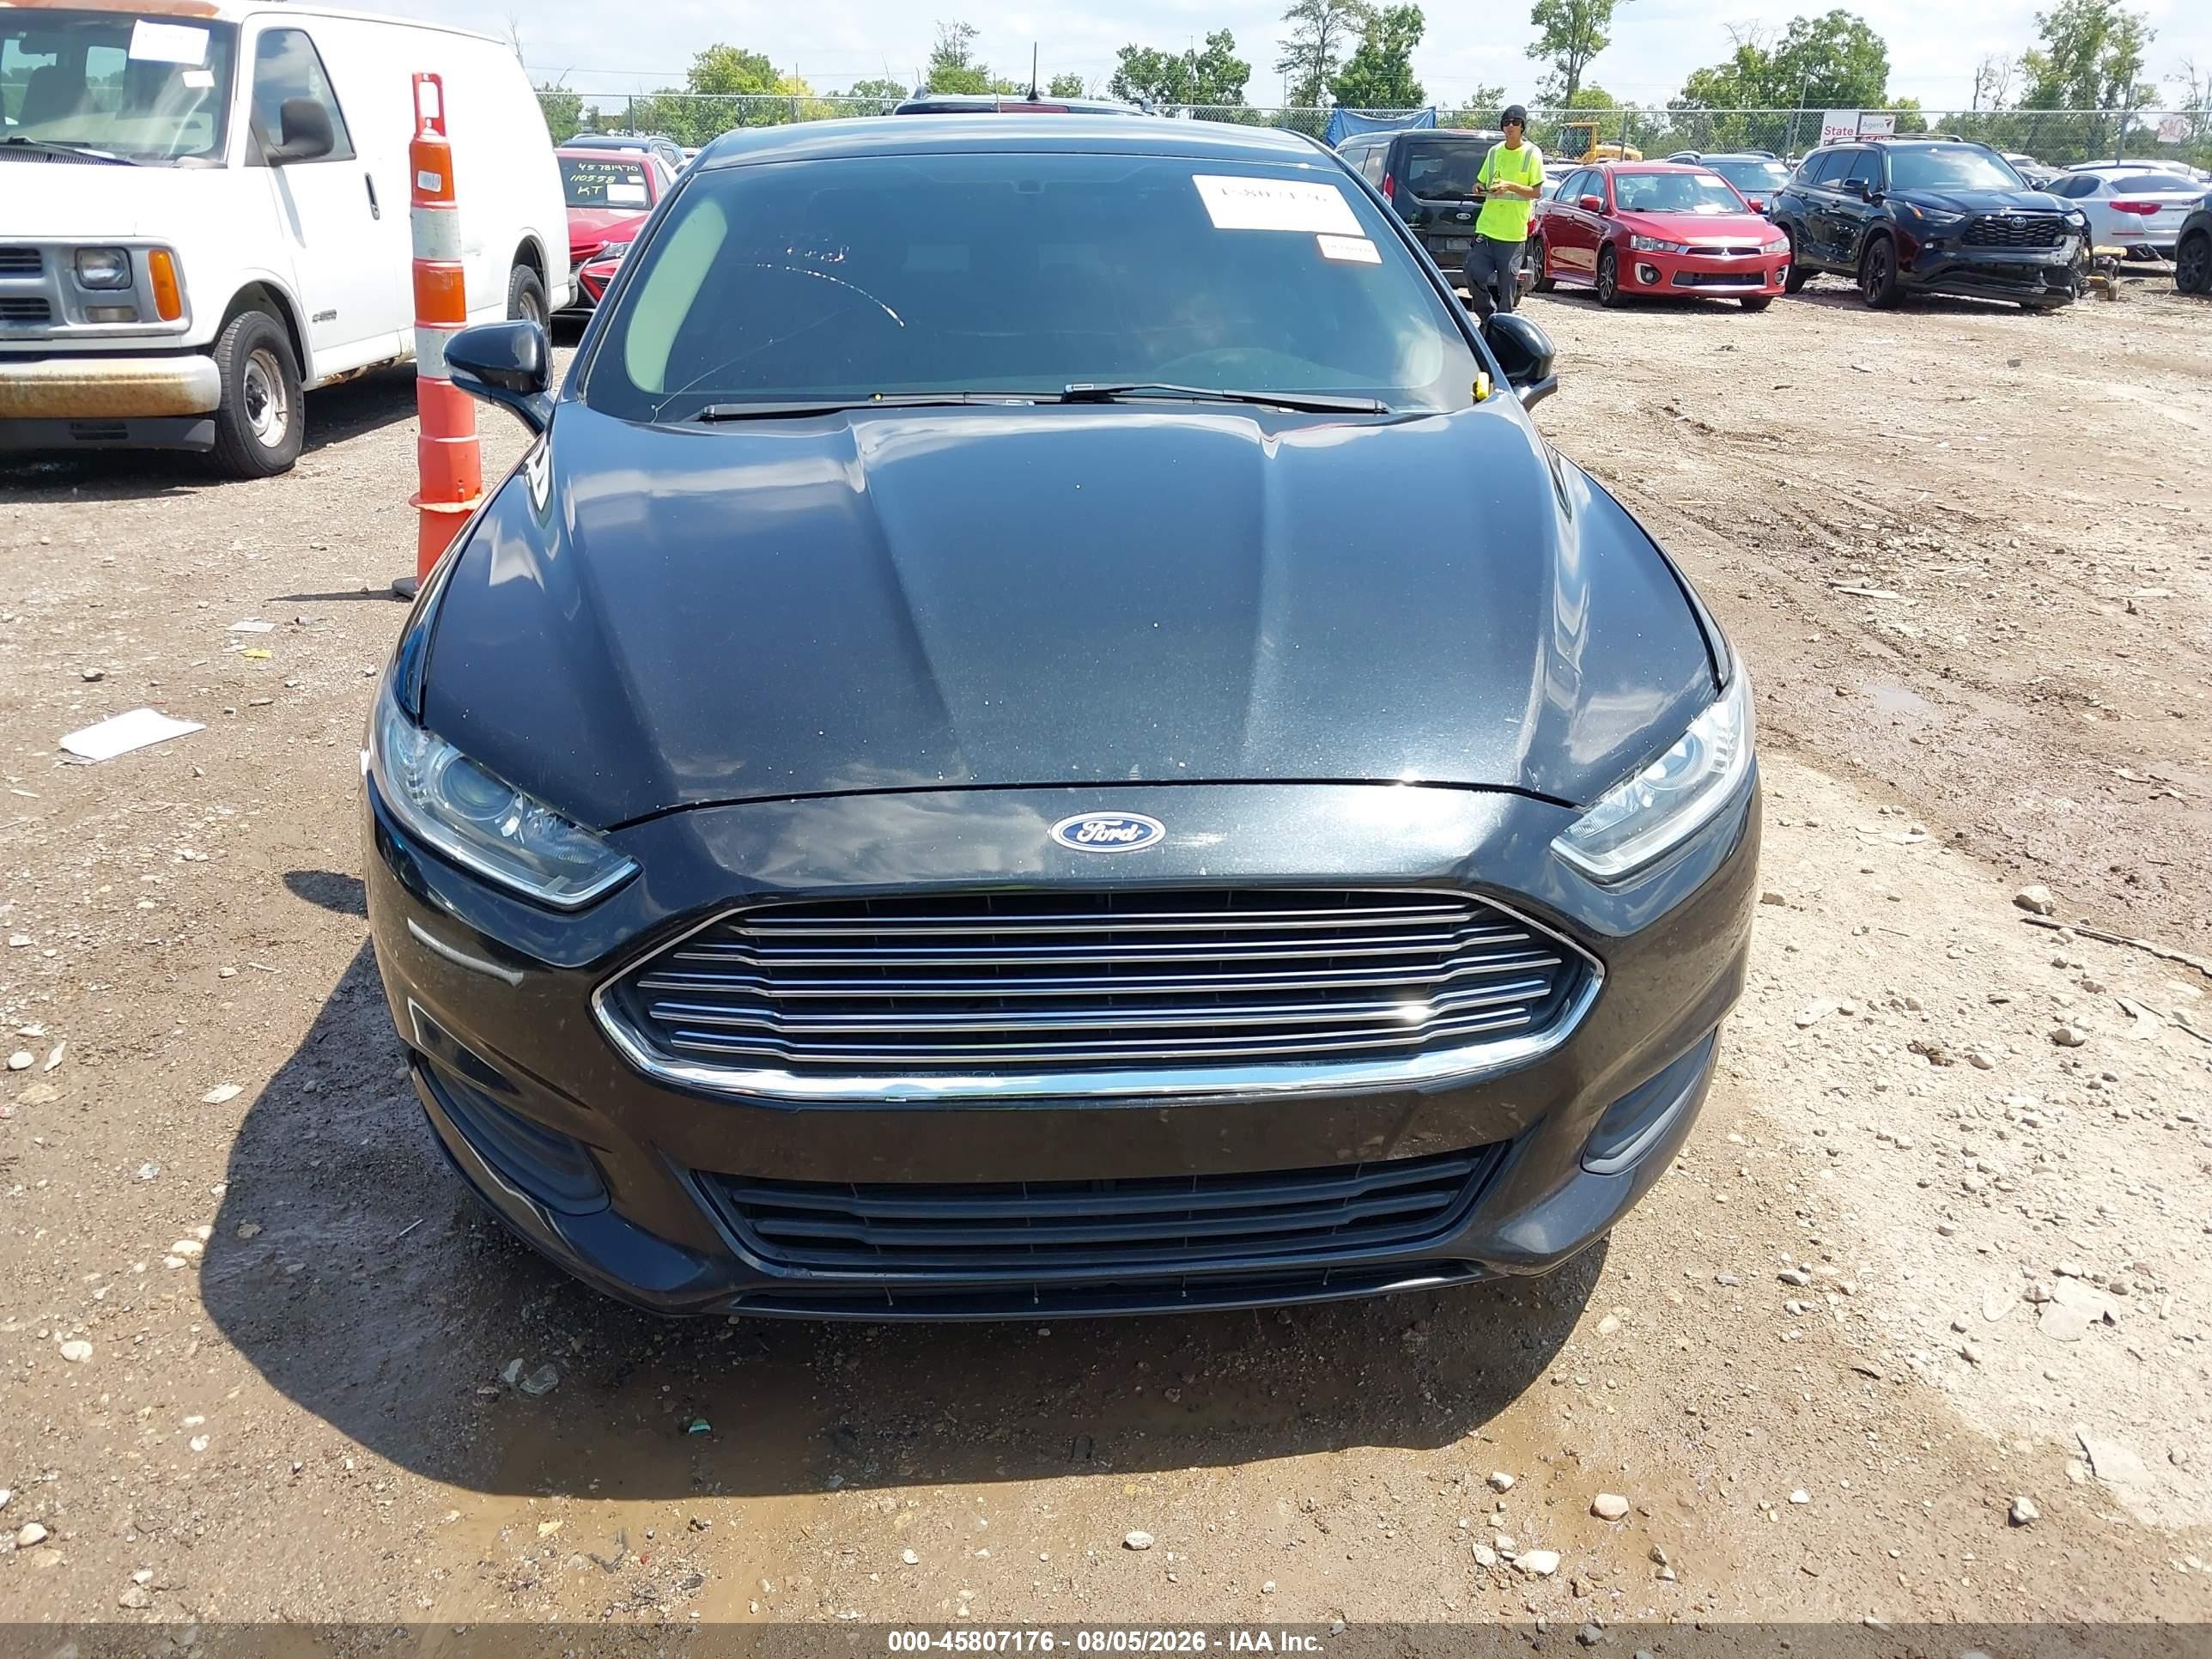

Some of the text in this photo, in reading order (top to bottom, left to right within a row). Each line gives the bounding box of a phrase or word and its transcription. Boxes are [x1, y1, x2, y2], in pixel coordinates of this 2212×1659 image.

[1824, 125, 1854, 136] State
[1863, 121, 1884, 130] Agero
[569, 174, 617, 184] 110558
[577, 185, 603, 196] KT
[1076, 820, 1144, 842] Ford
